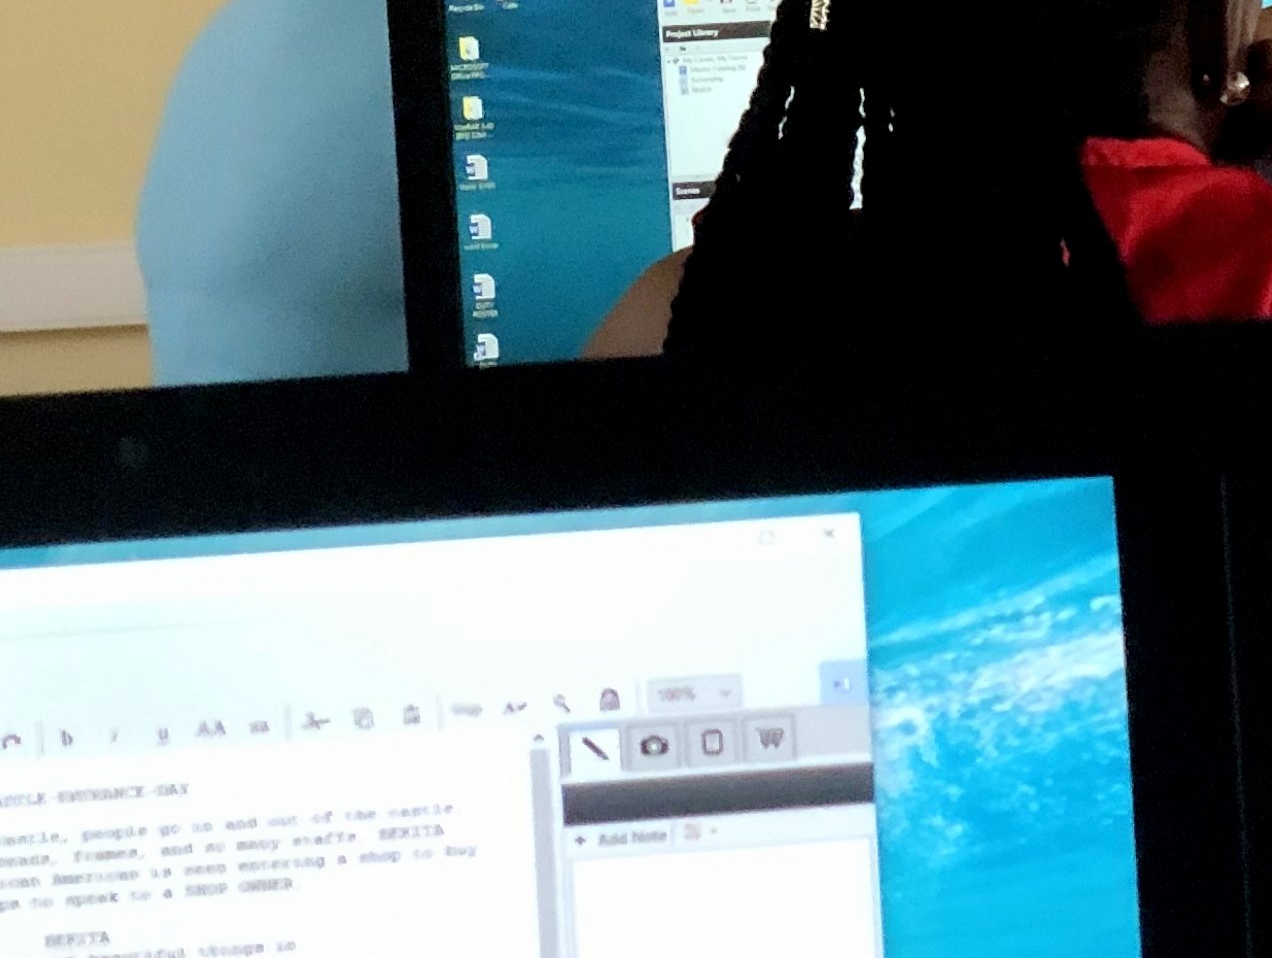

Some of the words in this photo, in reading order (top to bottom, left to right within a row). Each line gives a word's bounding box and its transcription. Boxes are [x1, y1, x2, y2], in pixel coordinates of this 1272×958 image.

[665, 29, 692, 38] Project
[692, 29, 719, 38] Library
[159, 824, 180, 838] go
[225, 817, 258, 831] and
[267, 815, 298, 827] out
[344, 809, 377, 821] the
[160, 843, 193, 857] and
[204, 842, 226, 854] so
[236, 838, 280, 851] many
[598, 834, 628, 848] Add
[632, 831, 668, 844] Note
[52, 869, 139, 886] American
[151, 867, 173, 879] is
[184, 863, 227, 876] seen
[238, 856, 326, 873] entering
[337, 854, 348, 866] a
[358, 850, 402, 864] shop
[412, 848, 434, 860] to
[444, 845, 478, 858] buy
[65, 892, 119, 908] speak
[129, 890, 152, 902] to
[162, 888, 173, 900] a
[185, 882, 228, 897] SHOP
